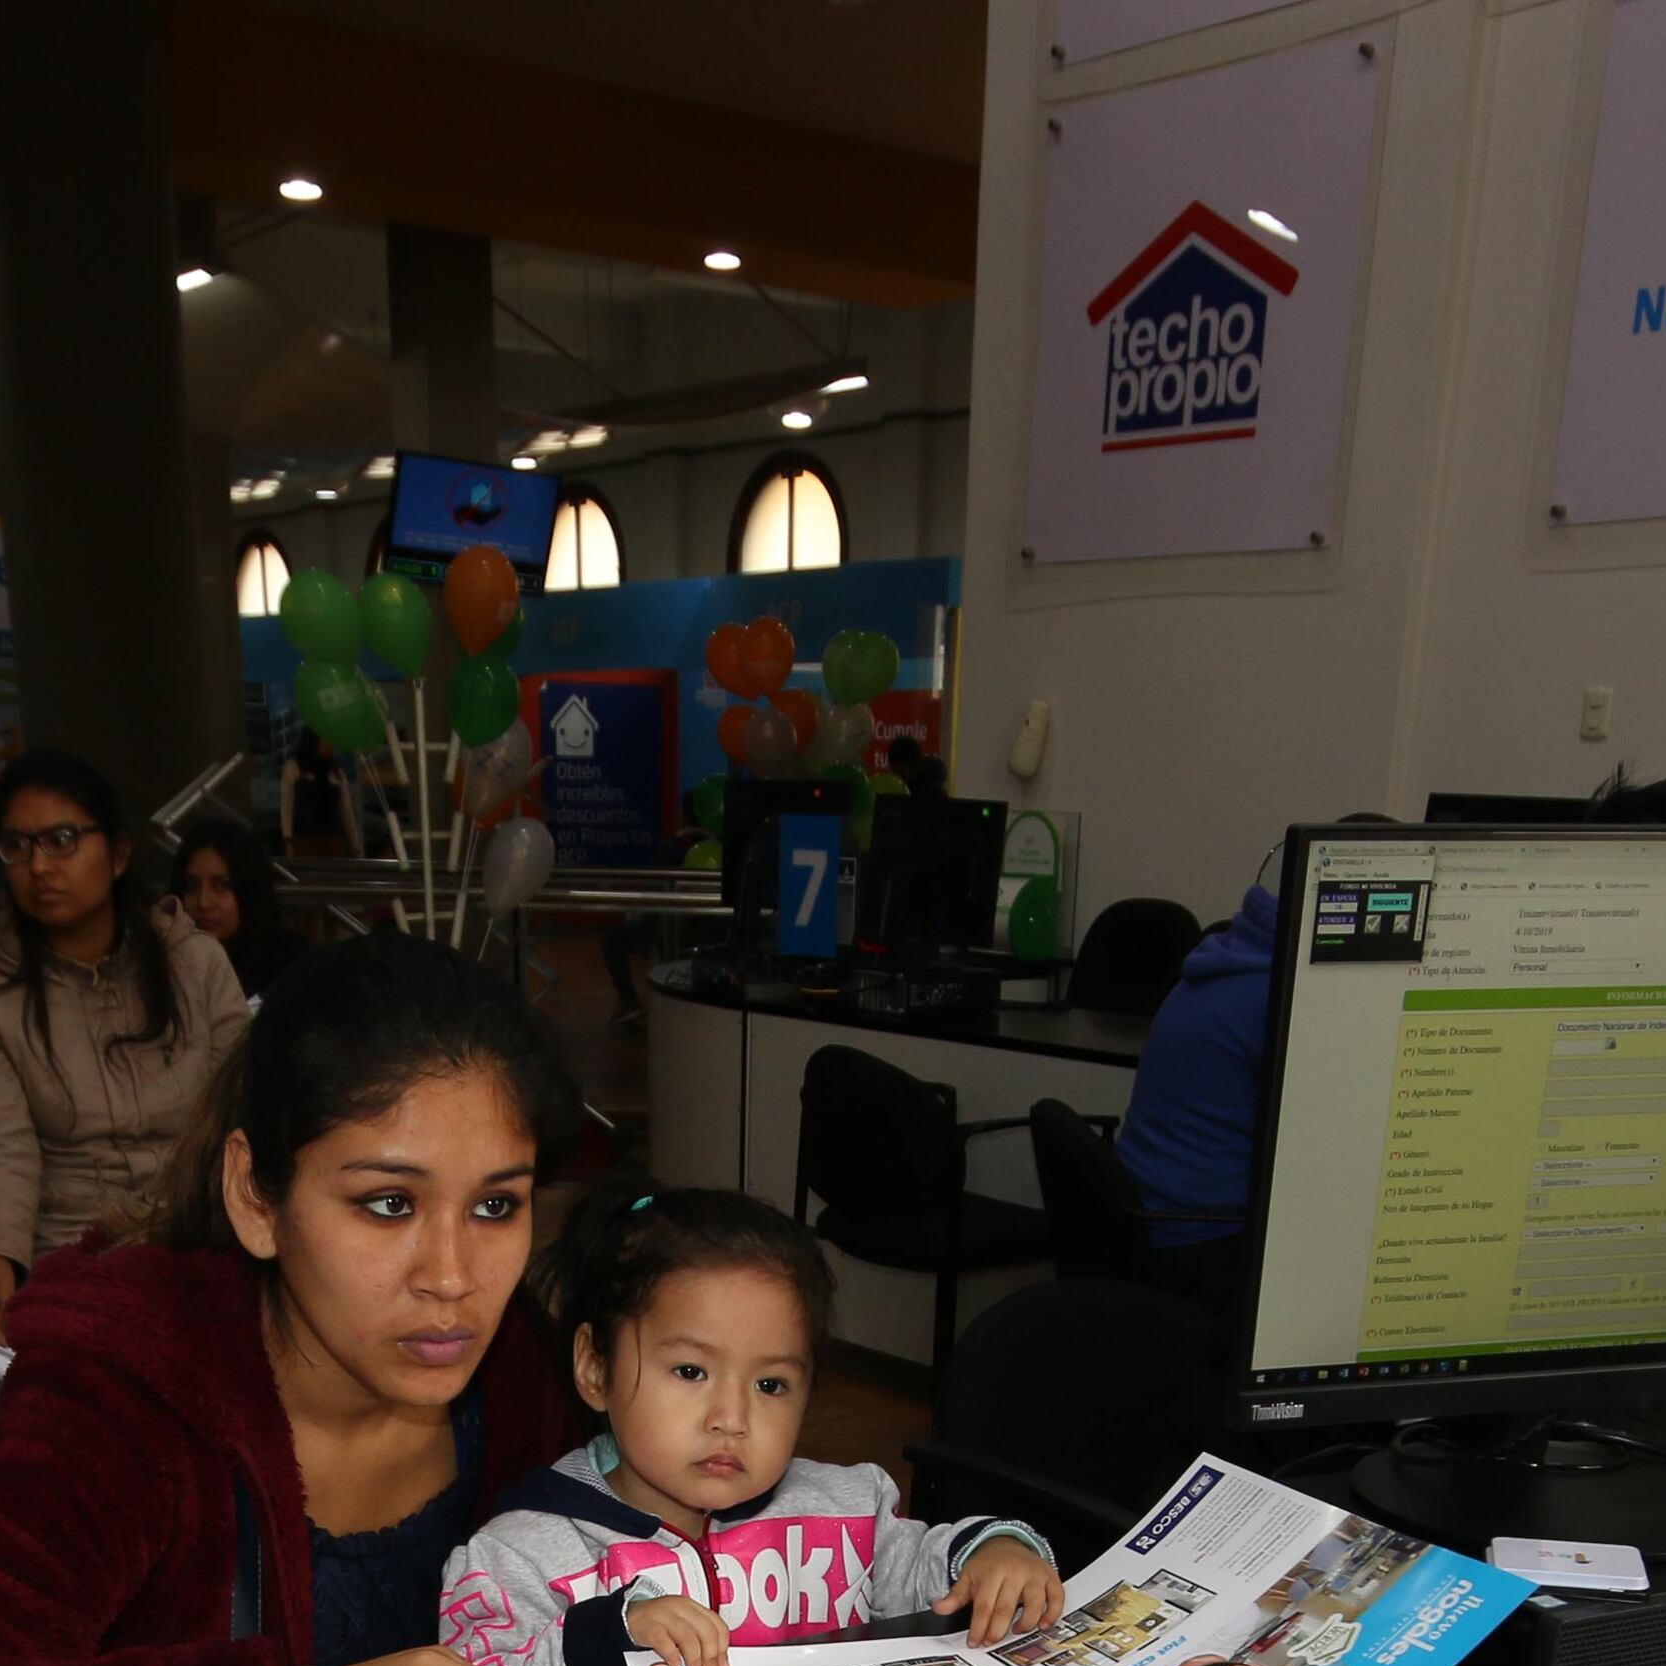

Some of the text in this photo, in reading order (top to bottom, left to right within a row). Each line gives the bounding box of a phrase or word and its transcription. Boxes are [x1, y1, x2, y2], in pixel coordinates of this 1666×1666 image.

[1109, 292, 1254, 371] techo
[1107, 350, 1261, 432] propio
[556, 760, 602, 780] Obtén
[791, 848, 829, 927] 7
[1513, 962, 1548, 973] Personal
[1557, 1021, 1599, 1032] Documento
[1601, 1020, 1636, 1031] Nacional
[1251, 1401, 1305, 1423] ThinkVision
[1151, 1496, 1193, 1536] BESCO
[1377, 1578, 1473, 1666] nogales
[1162, 1634, 1187, 1653] Flat
